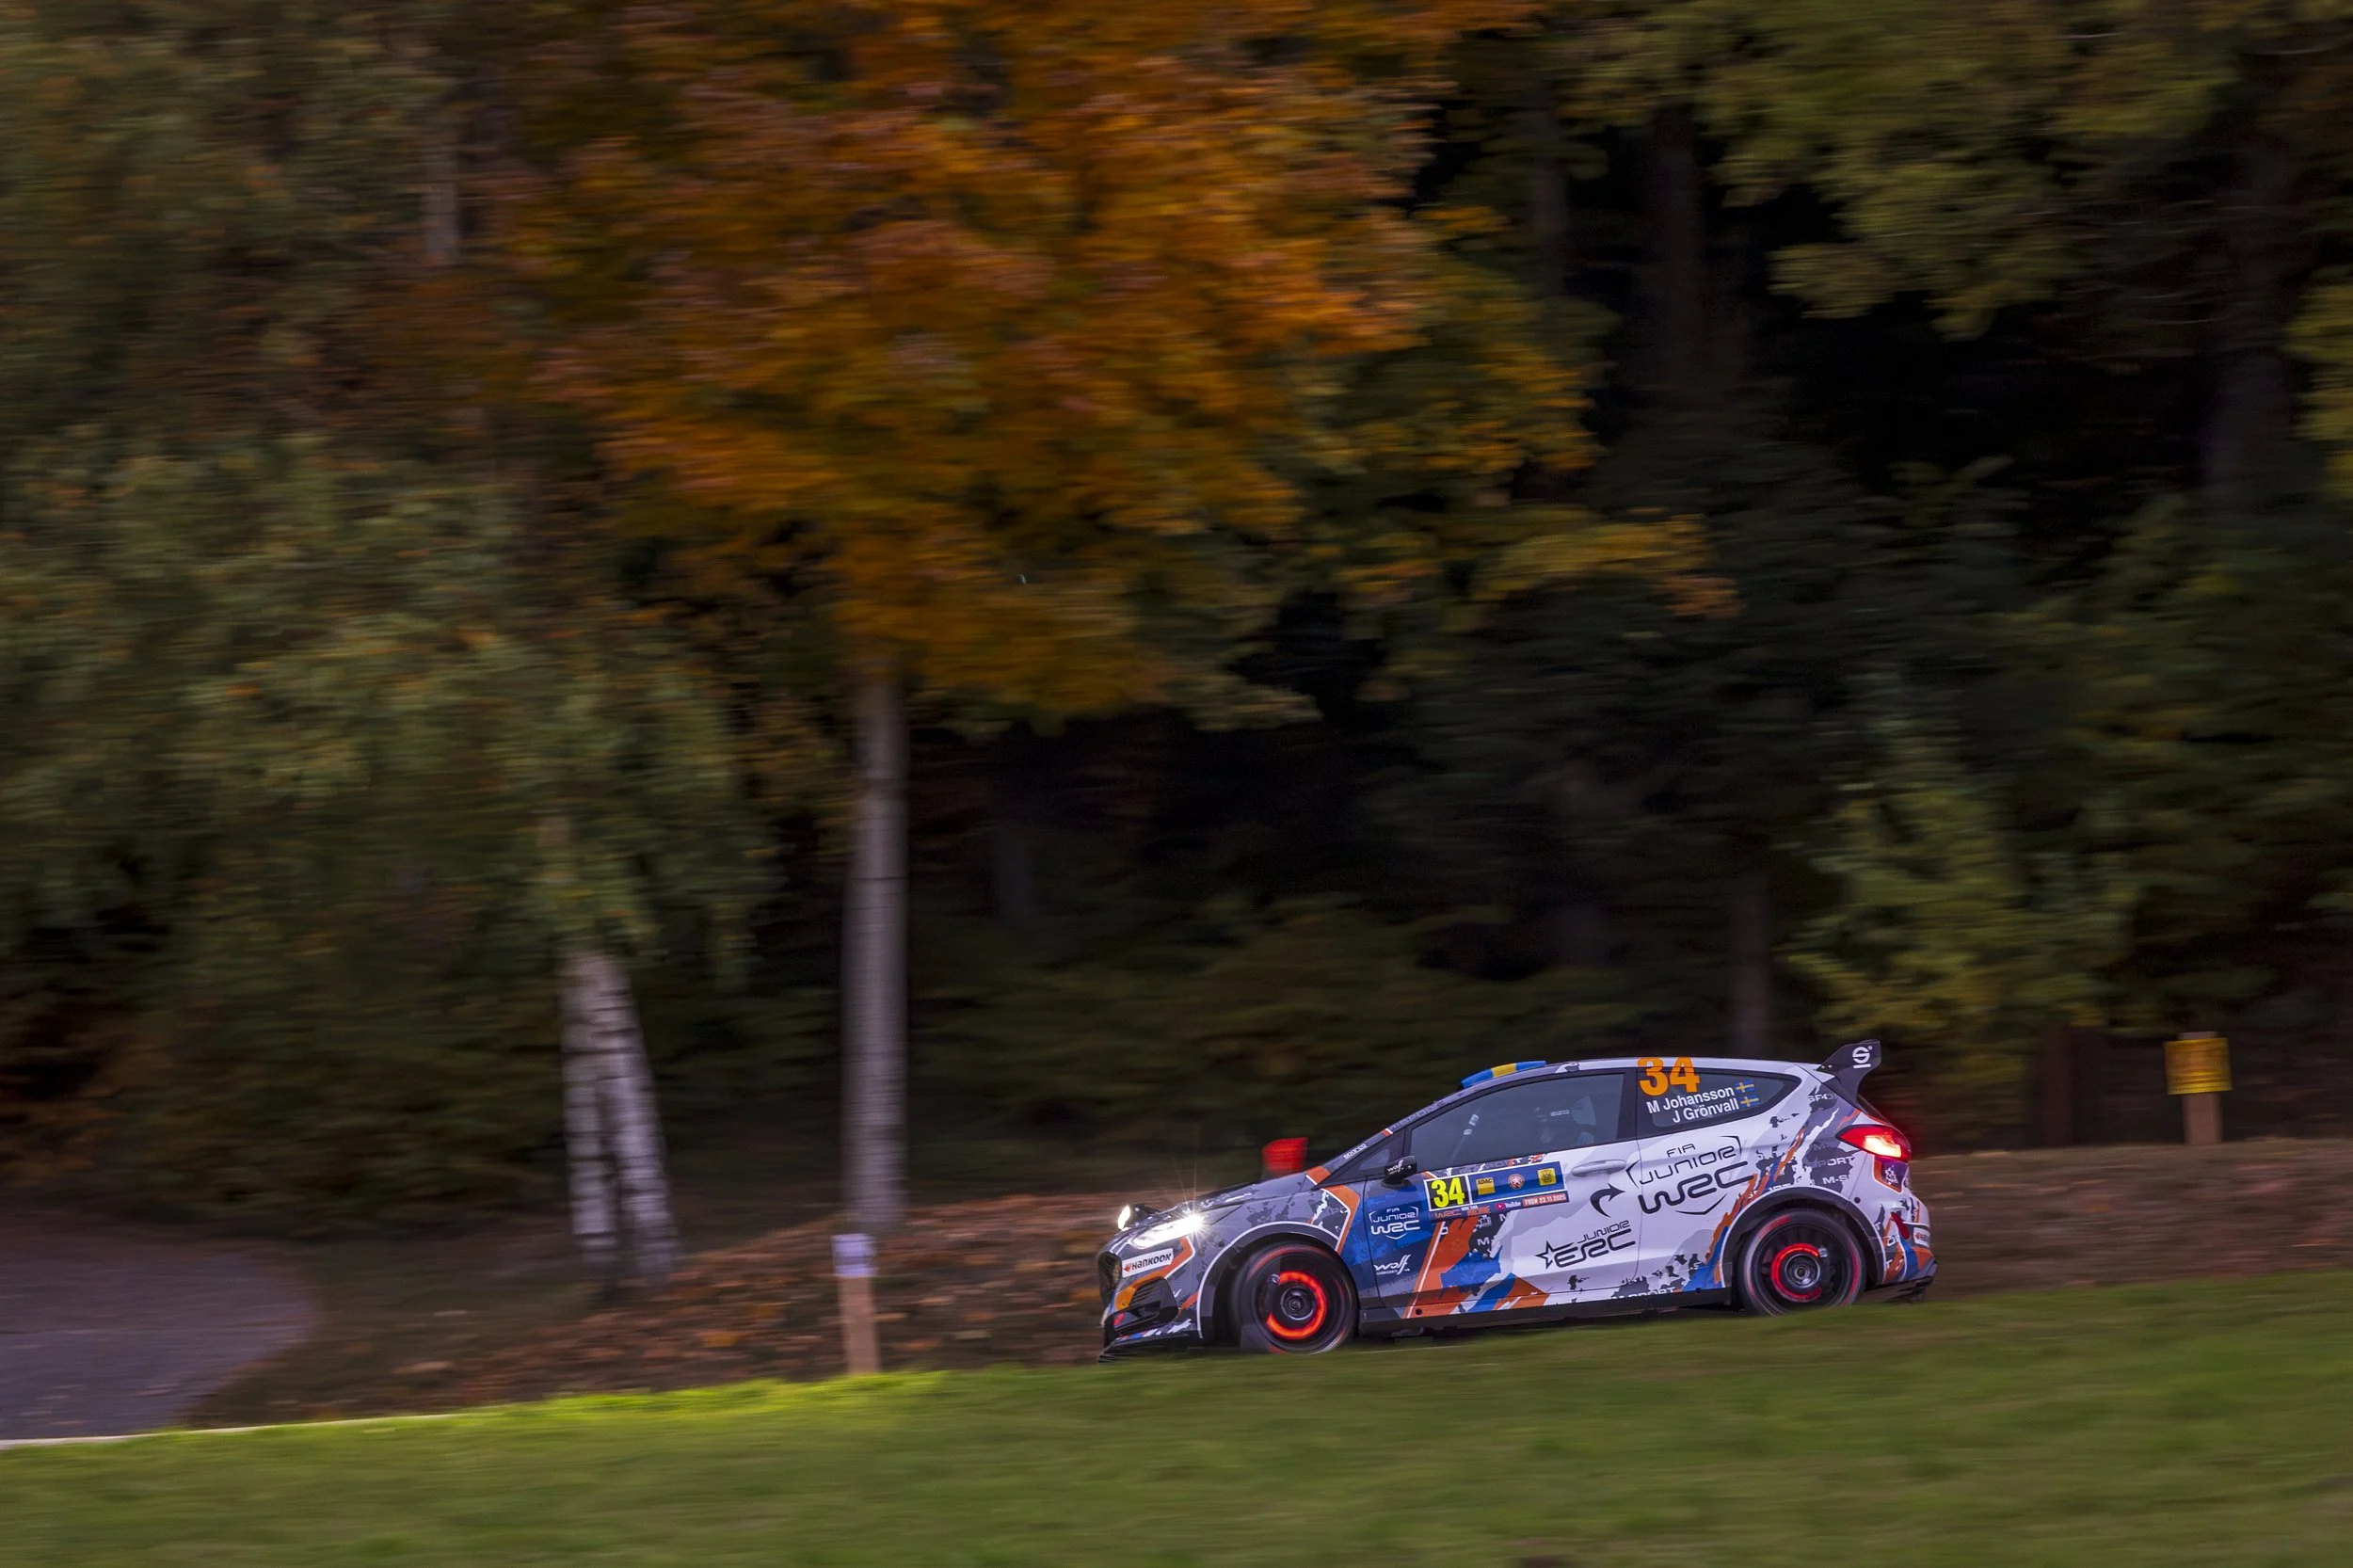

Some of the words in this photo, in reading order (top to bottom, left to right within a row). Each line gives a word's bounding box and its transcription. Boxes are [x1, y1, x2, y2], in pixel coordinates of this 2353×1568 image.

[1637, 1056, 1701, 1096] 34
[1646, 1100, 1660, 1113] M
[1663, 1086, 1735, 1112] Johansson
[1673, 1109, 1680, 1124] J
[1683, 1098, 1739, 1120] Grönvall
[1666, 1144, 1696, 1158] FIA
[1639, 1145, 1737, 1186] JUNIOR
[1430, 1176, 1465, 1208] 34
[1638, 1160, 1755, 1215] WRC
[1370, 1220, 1420, 1235] WRC
[1372, 1211, 1416, 1223] JUNIOR
[1577, 1220, 1631, 1244] JUNIOR
